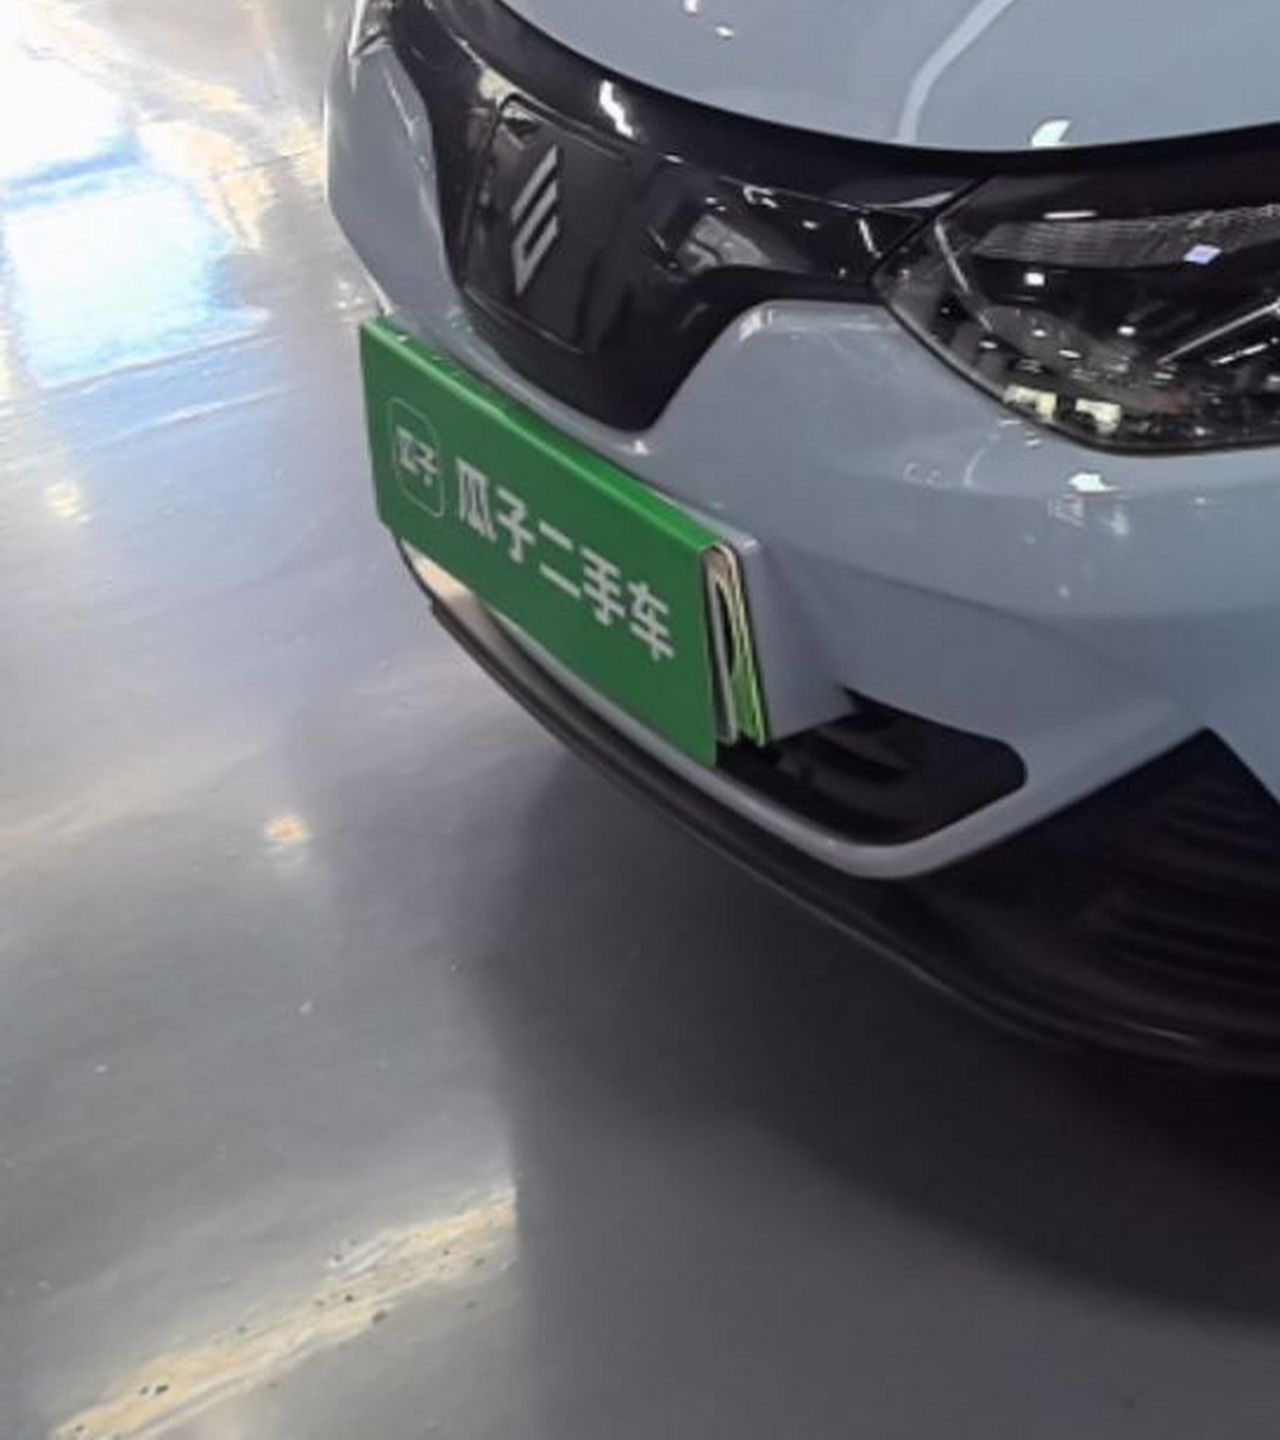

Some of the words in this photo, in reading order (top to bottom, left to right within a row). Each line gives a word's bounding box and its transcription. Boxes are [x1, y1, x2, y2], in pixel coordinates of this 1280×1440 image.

[455, 455, 675, 661] 瓜子二手车
